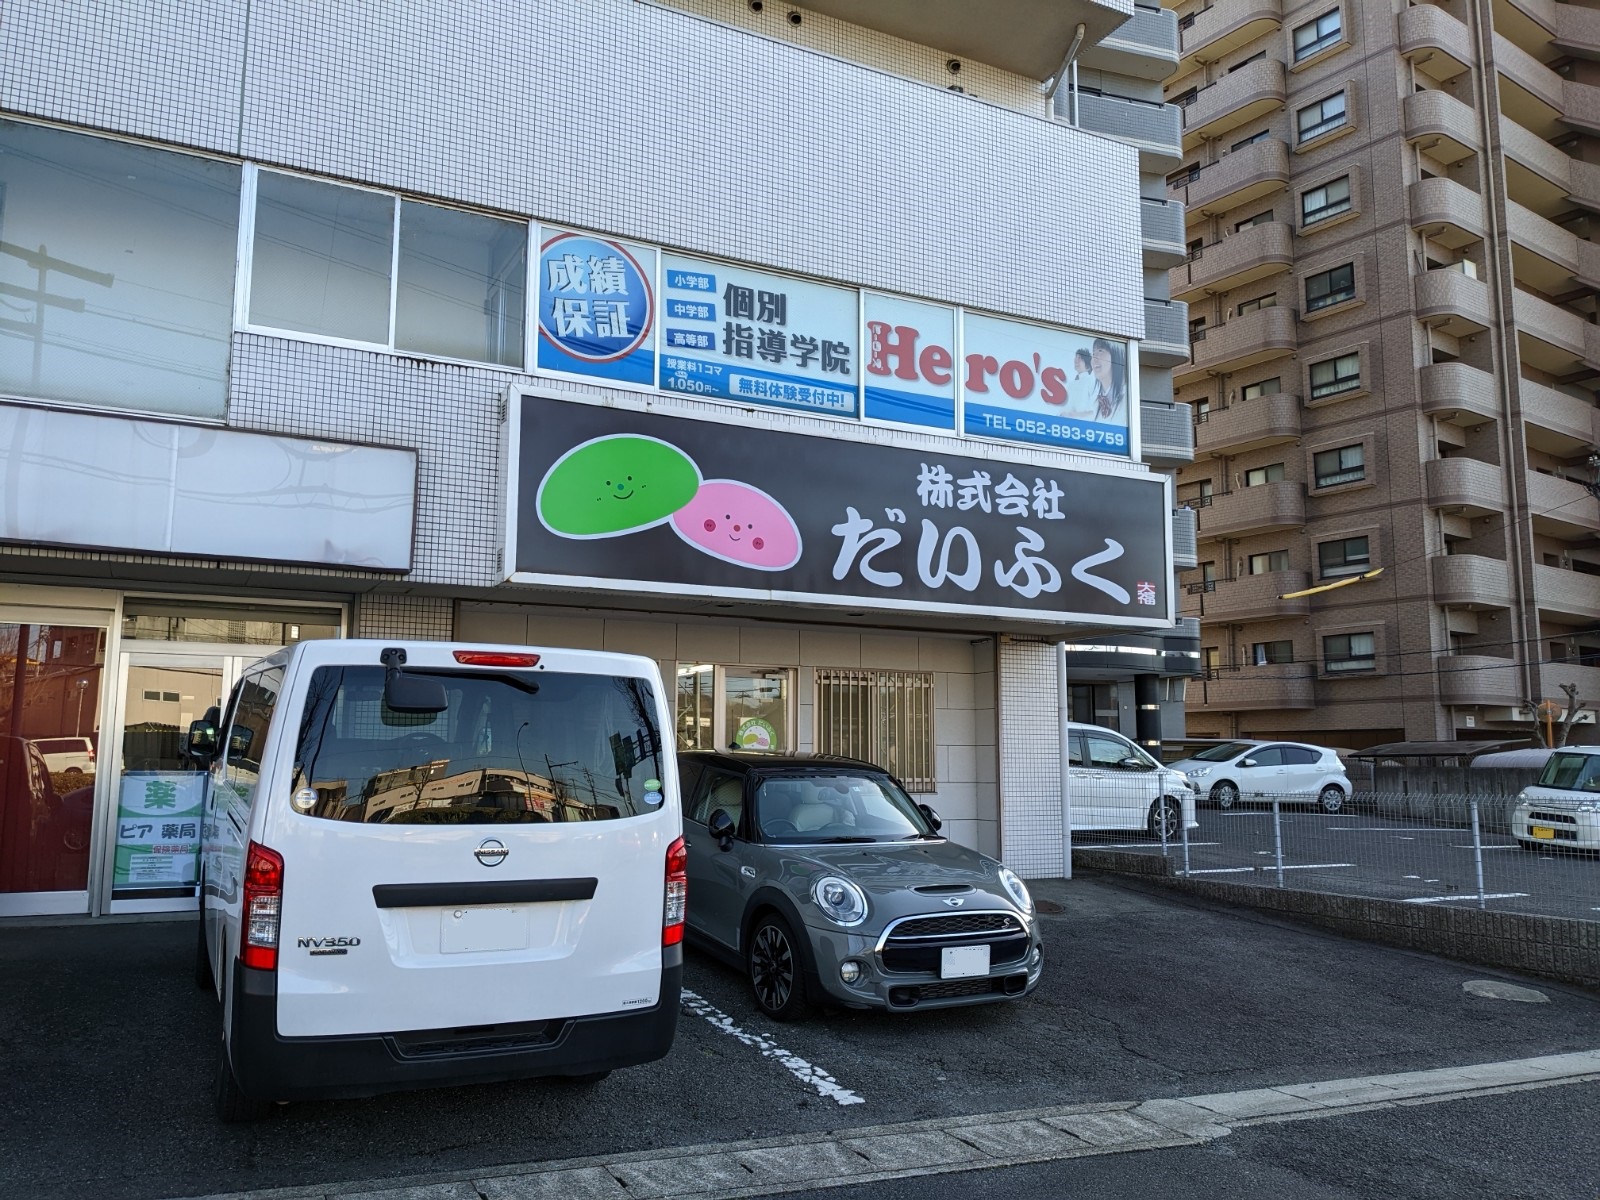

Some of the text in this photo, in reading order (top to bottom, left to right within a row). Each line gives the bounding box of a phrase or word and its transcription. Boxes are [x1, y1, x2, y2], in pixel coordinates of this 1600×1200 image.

[547, 254, 629, 295] 成績
[674, 275, 709, 289] 小学部
[552, 297, 634, 337] 保証
[674, 304, 709, 319] 中学部
[723, 283, 787, 326] 個別
[673, 332, 709, 348] 高等部
[722, 322, 851, 375] 指導学院
[867, 321, 1068, 405] Hero's
[982, 413, 1125, 447] TEL 052-893-9759
[916, 463, 1066, 520] 株式会社
[831, 506, 1131, 605] だいふく
[144, 780, 177, 809] 薬
[120, 824, 153, 839] ピア
[161, 823, 196, 839] 薬局
[297, 936, 361, 948] NV350
